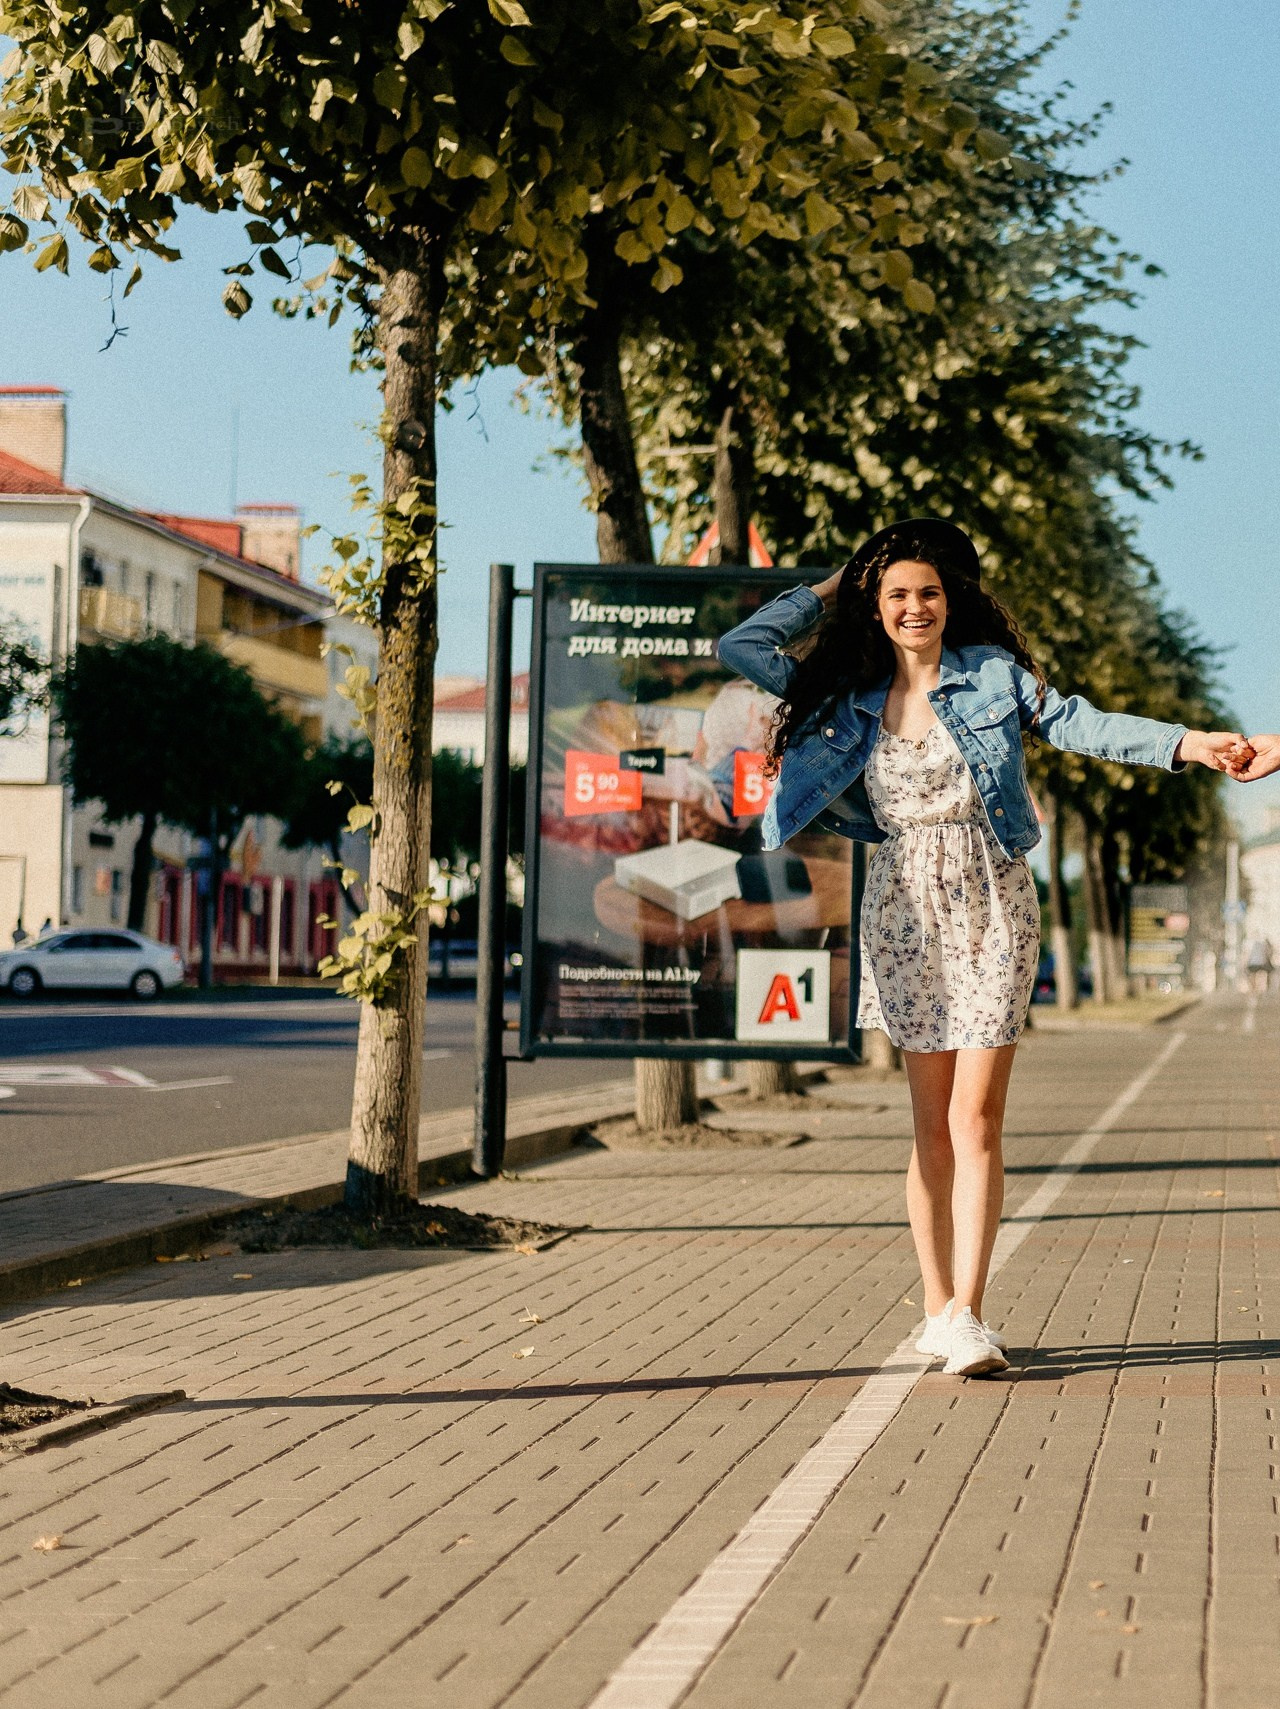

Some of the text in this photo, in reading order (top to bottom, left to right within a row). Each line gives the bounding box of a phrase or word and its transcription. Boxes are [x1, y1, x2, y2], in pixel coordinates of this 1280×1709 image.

[569, 598, 696, 629] Интернет
[567, 635, 713, 658] для дома и
[575, 773, 595, 803] 5
[597, 773, 619, 791] 90
[743, 773, 764, 803] 5
[558, 963, 644, 982] Подробности
[645, 969, 663, 981] на
[758, 967, 815, 1025] A1
